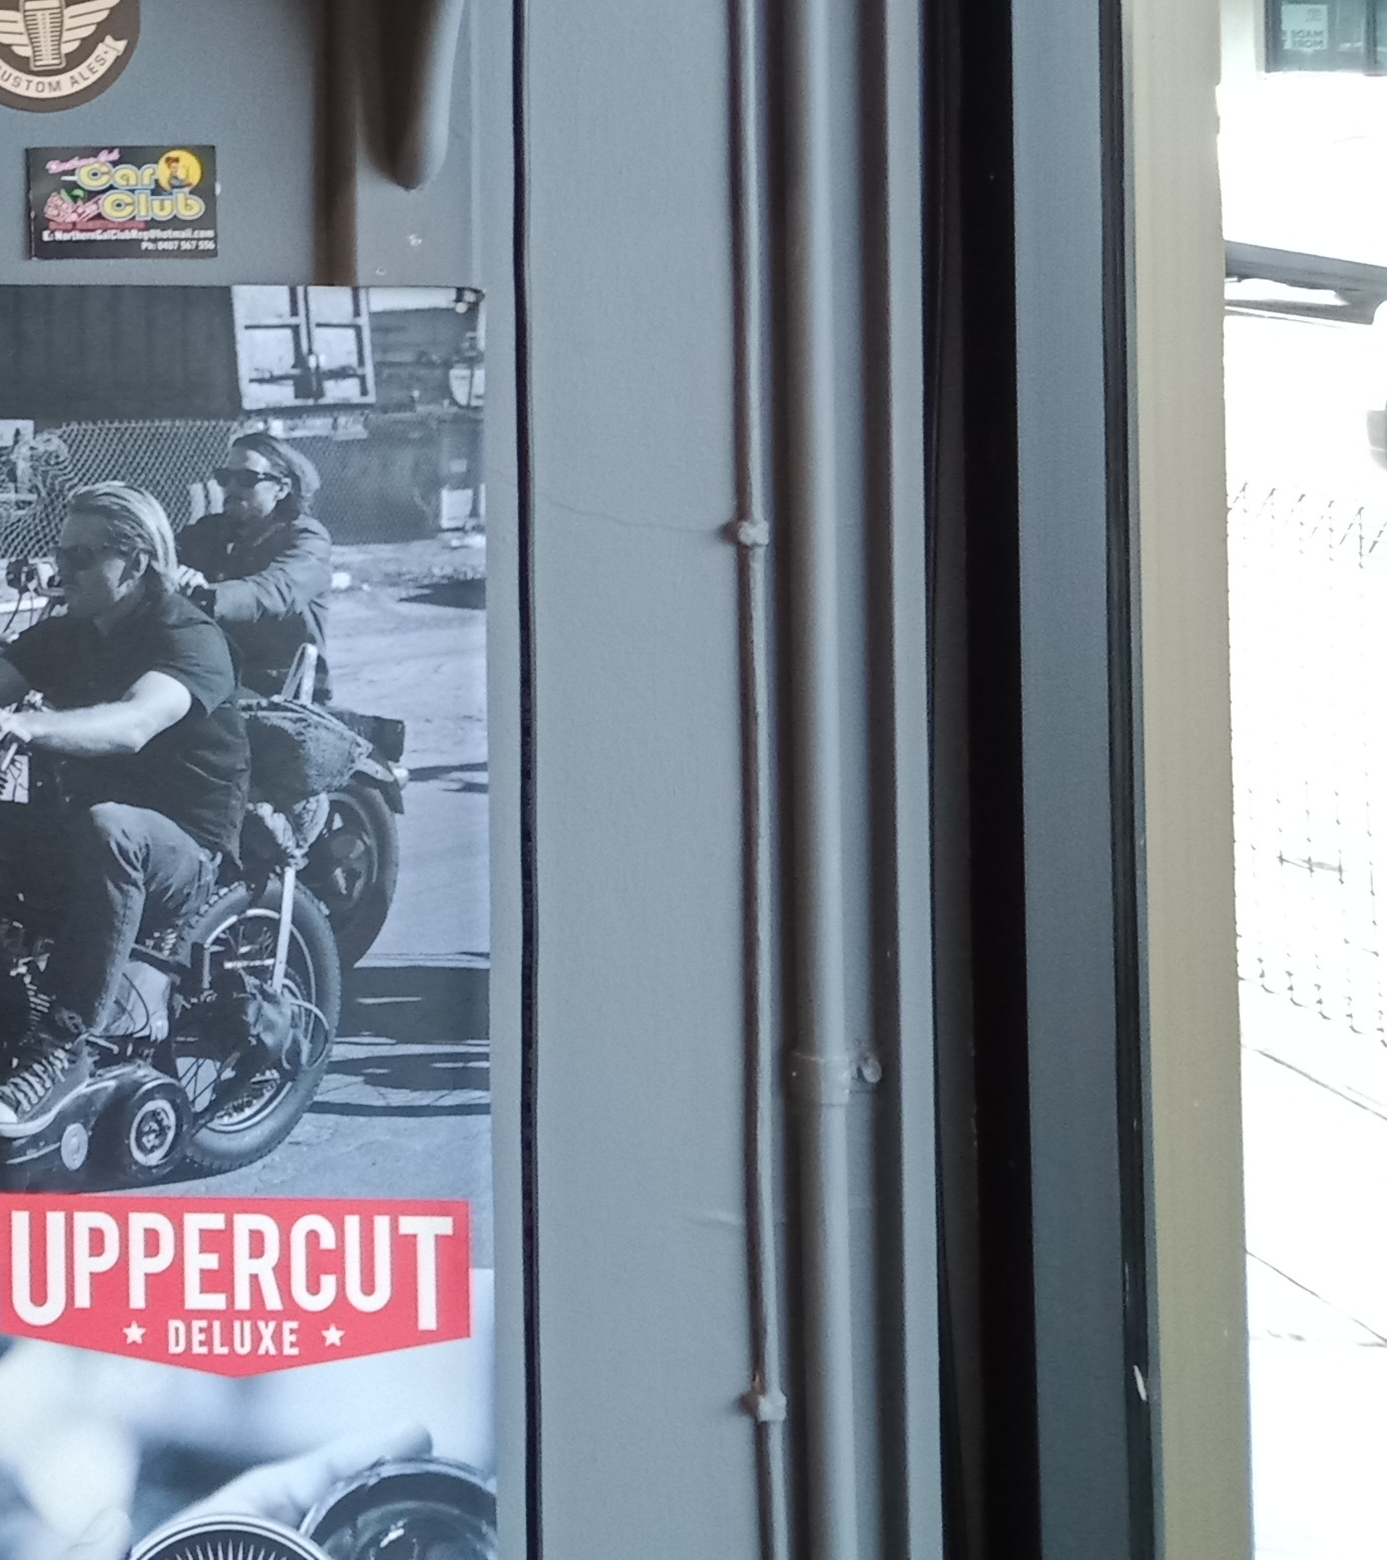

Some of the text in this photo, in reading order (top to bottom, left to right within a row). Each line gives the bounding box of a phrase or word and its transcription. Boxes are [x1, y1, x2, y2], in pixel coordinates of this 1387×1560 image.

[70, 52, 108, 88] ALES
[75, 161, 159, 190] Car
[99, 189, 206, 221] Club
[10, 1210, 455, 1331] UPPERCUT
[167, 1319, 300, 1356] DELUXE
